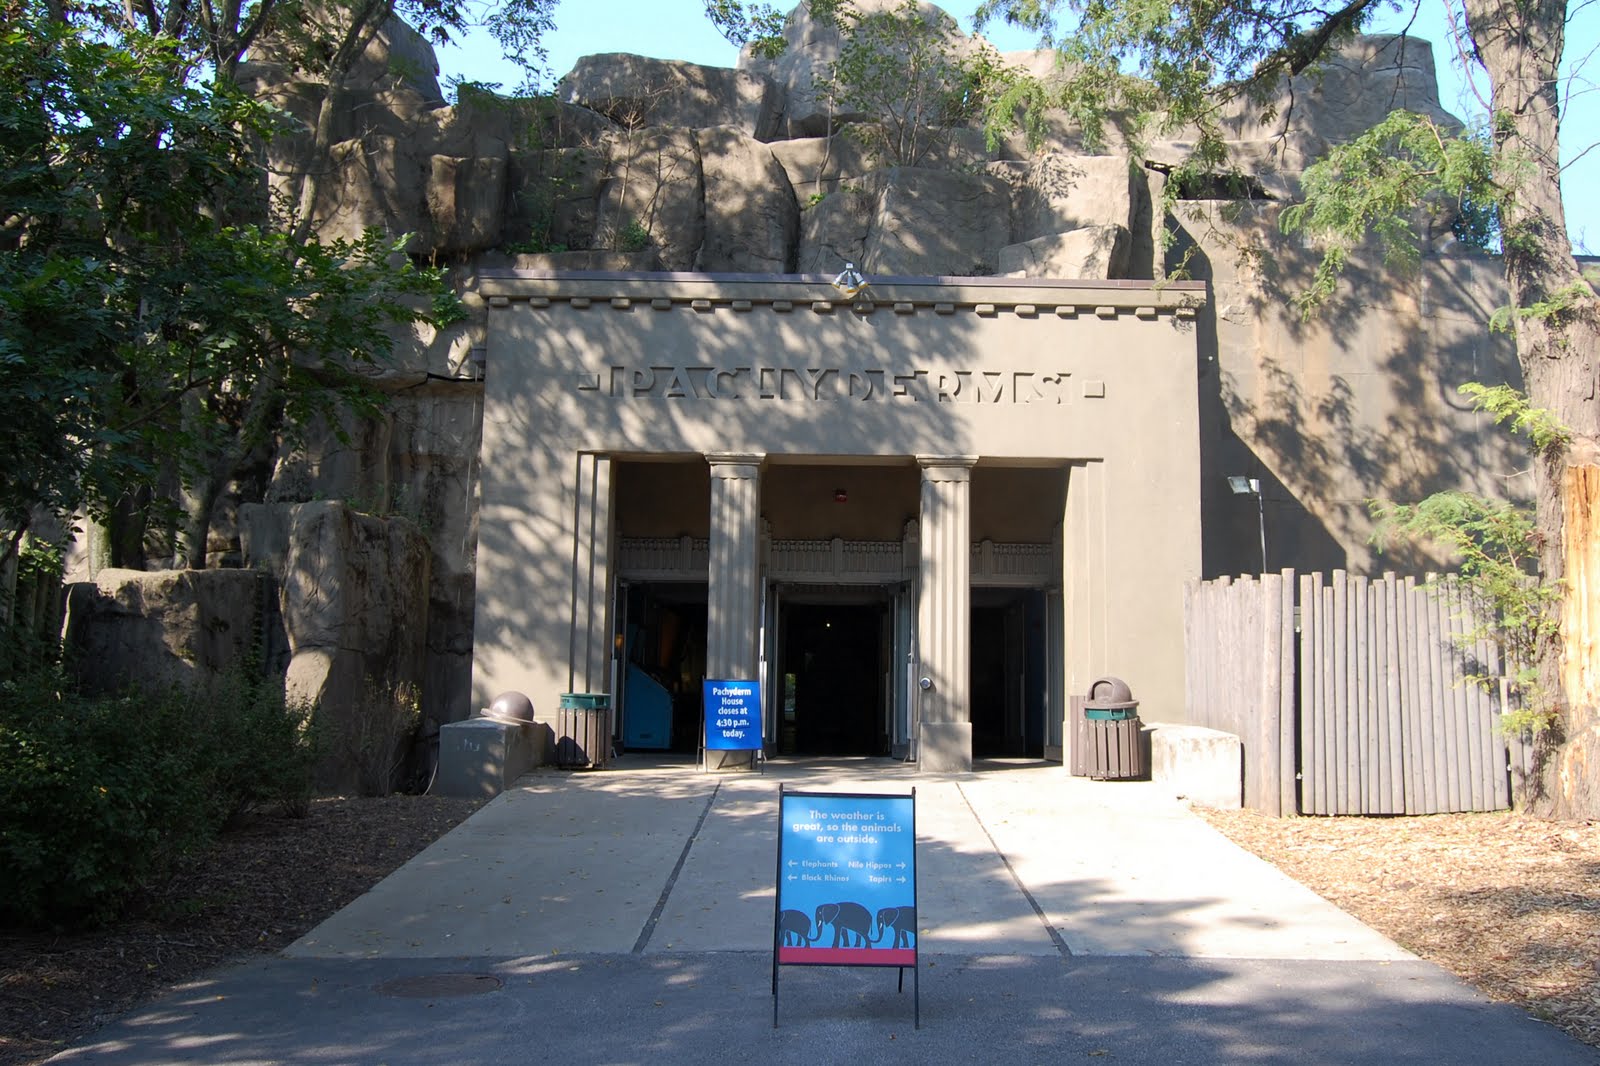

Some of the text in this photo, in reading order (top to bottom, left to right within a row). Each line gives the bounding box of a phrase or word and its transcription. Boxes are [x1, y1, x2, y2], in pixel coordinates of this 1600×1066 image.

[615, 366, 1068, 404] PACHYDERMS
[712, 687, 752, 697] Pachyderm
[721, 697, 744, 705] House
[717, 706, 748, 715] closes at
[716, 718, 750, 728] 4:30 p.m.
[722, 729, 745, 739] today.
[809, 810, 885, 821] The weather is
[792, 822, 902, 833] great, so the animals
[816, 834, 878, 844] are outside.
[801, 860, 839, 869] Elephants
[847, 861, 892, 870] Nile Hippos
[824, 874, 849, 882] Rhinos
[868, 875, 892, 884] Tapirs
